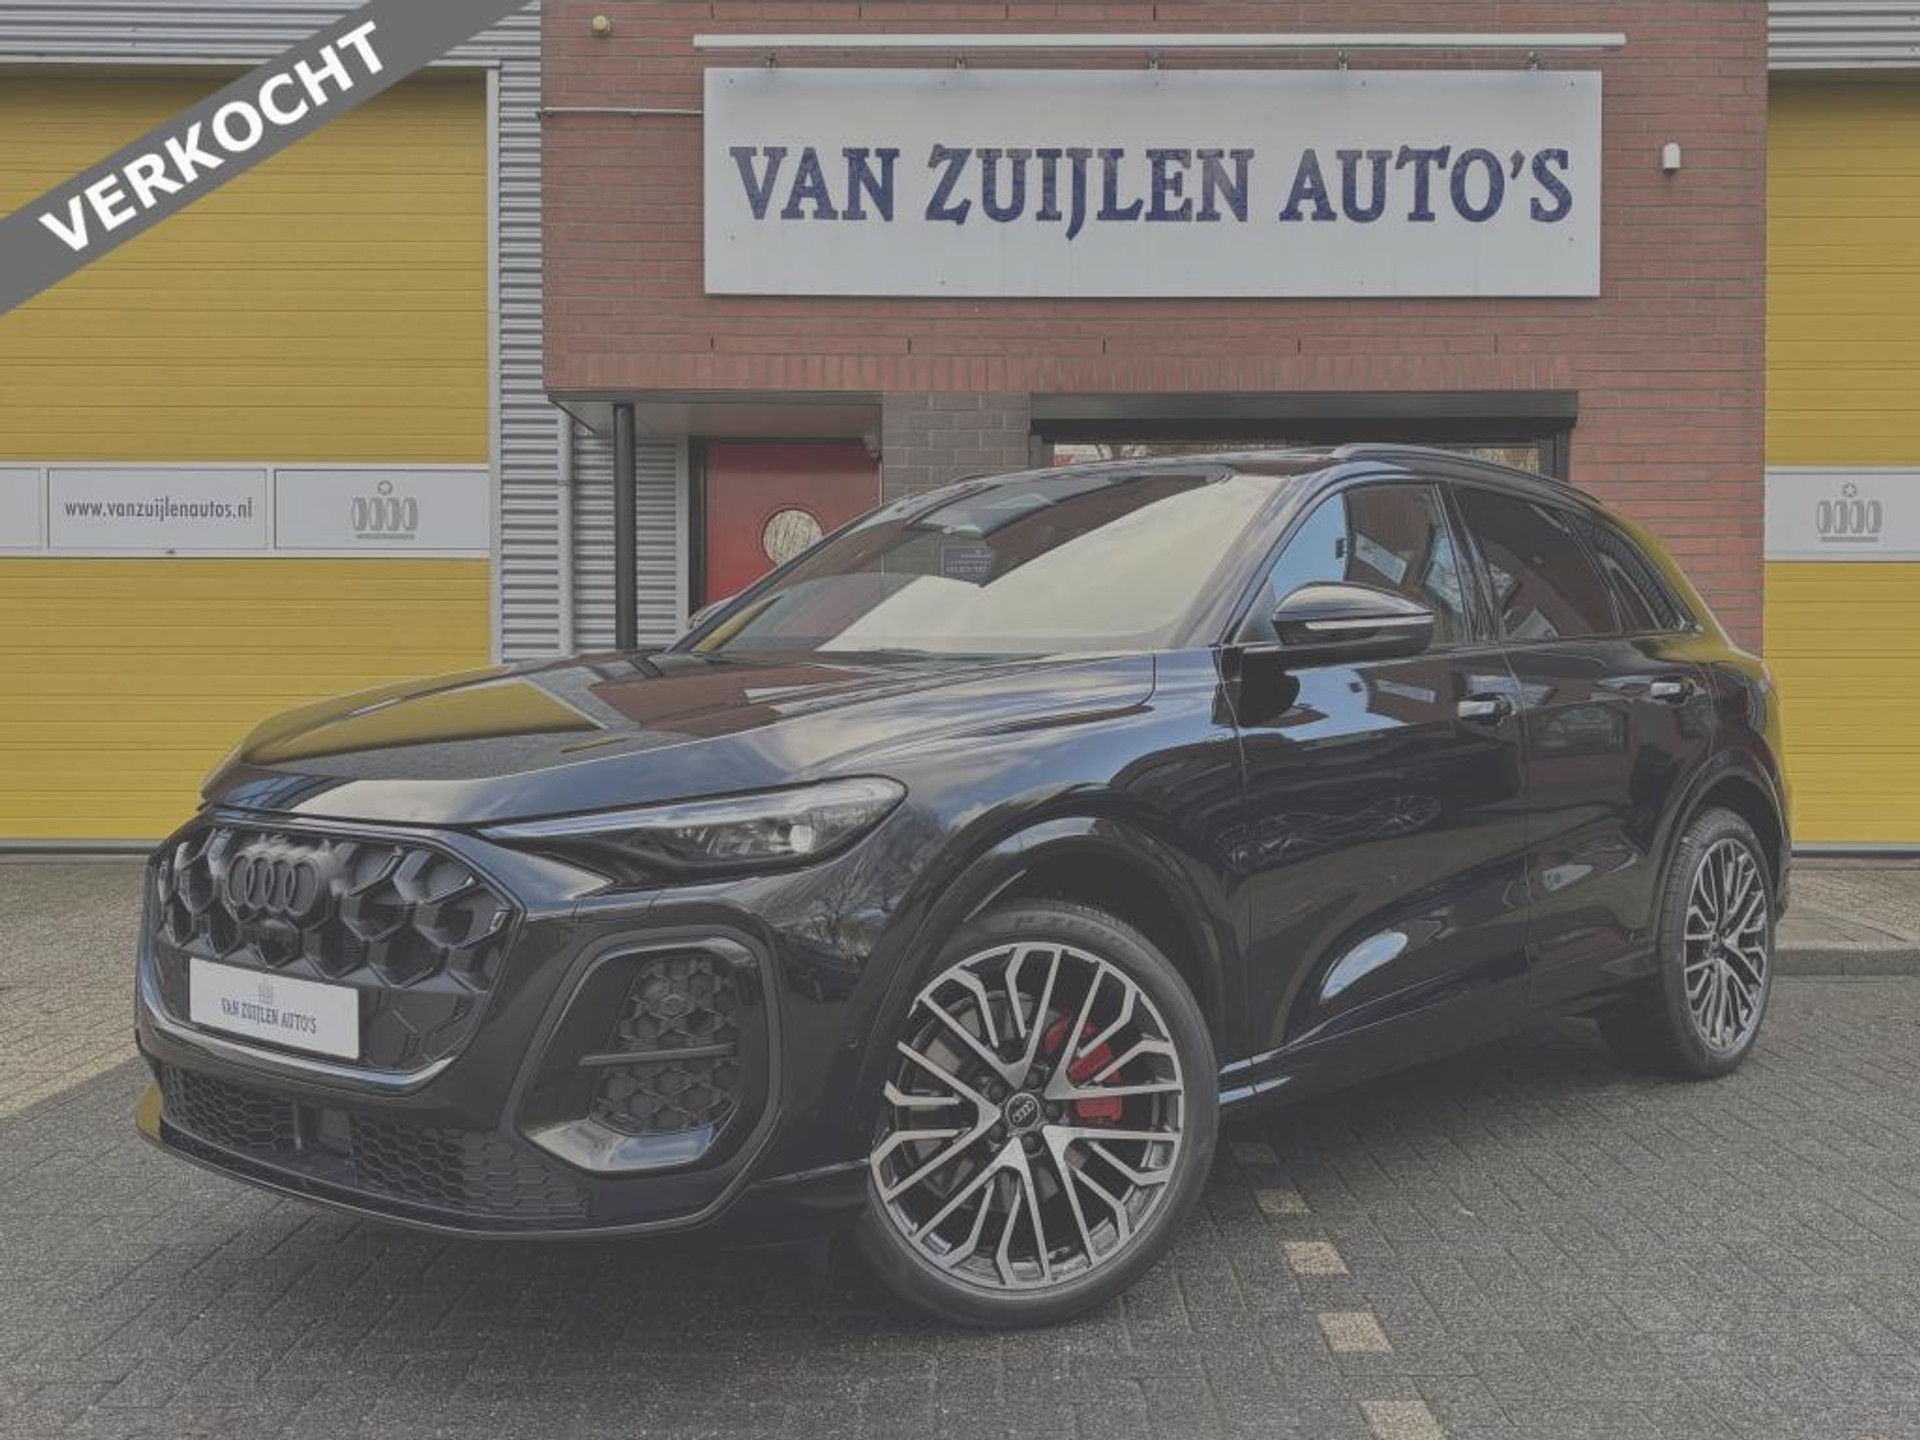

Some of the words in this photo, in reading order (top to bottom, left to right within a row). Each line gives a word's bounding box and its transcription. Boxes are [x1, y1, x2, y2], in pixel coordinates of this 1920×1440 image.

[731, 146, 900, 221] VAN
[926, 144, 1254, 240] ZUIJLEN
[1279, 144, 1573, 223] AUTO'S
[65, 496, 252, 522] www.vanzuijlenautos.nl
[221, 998, 241, 1016] VAN
[241, 1003, 279, 1025] ZUIJLEN
[281, 1011, 317, 1034] AUTO'S
